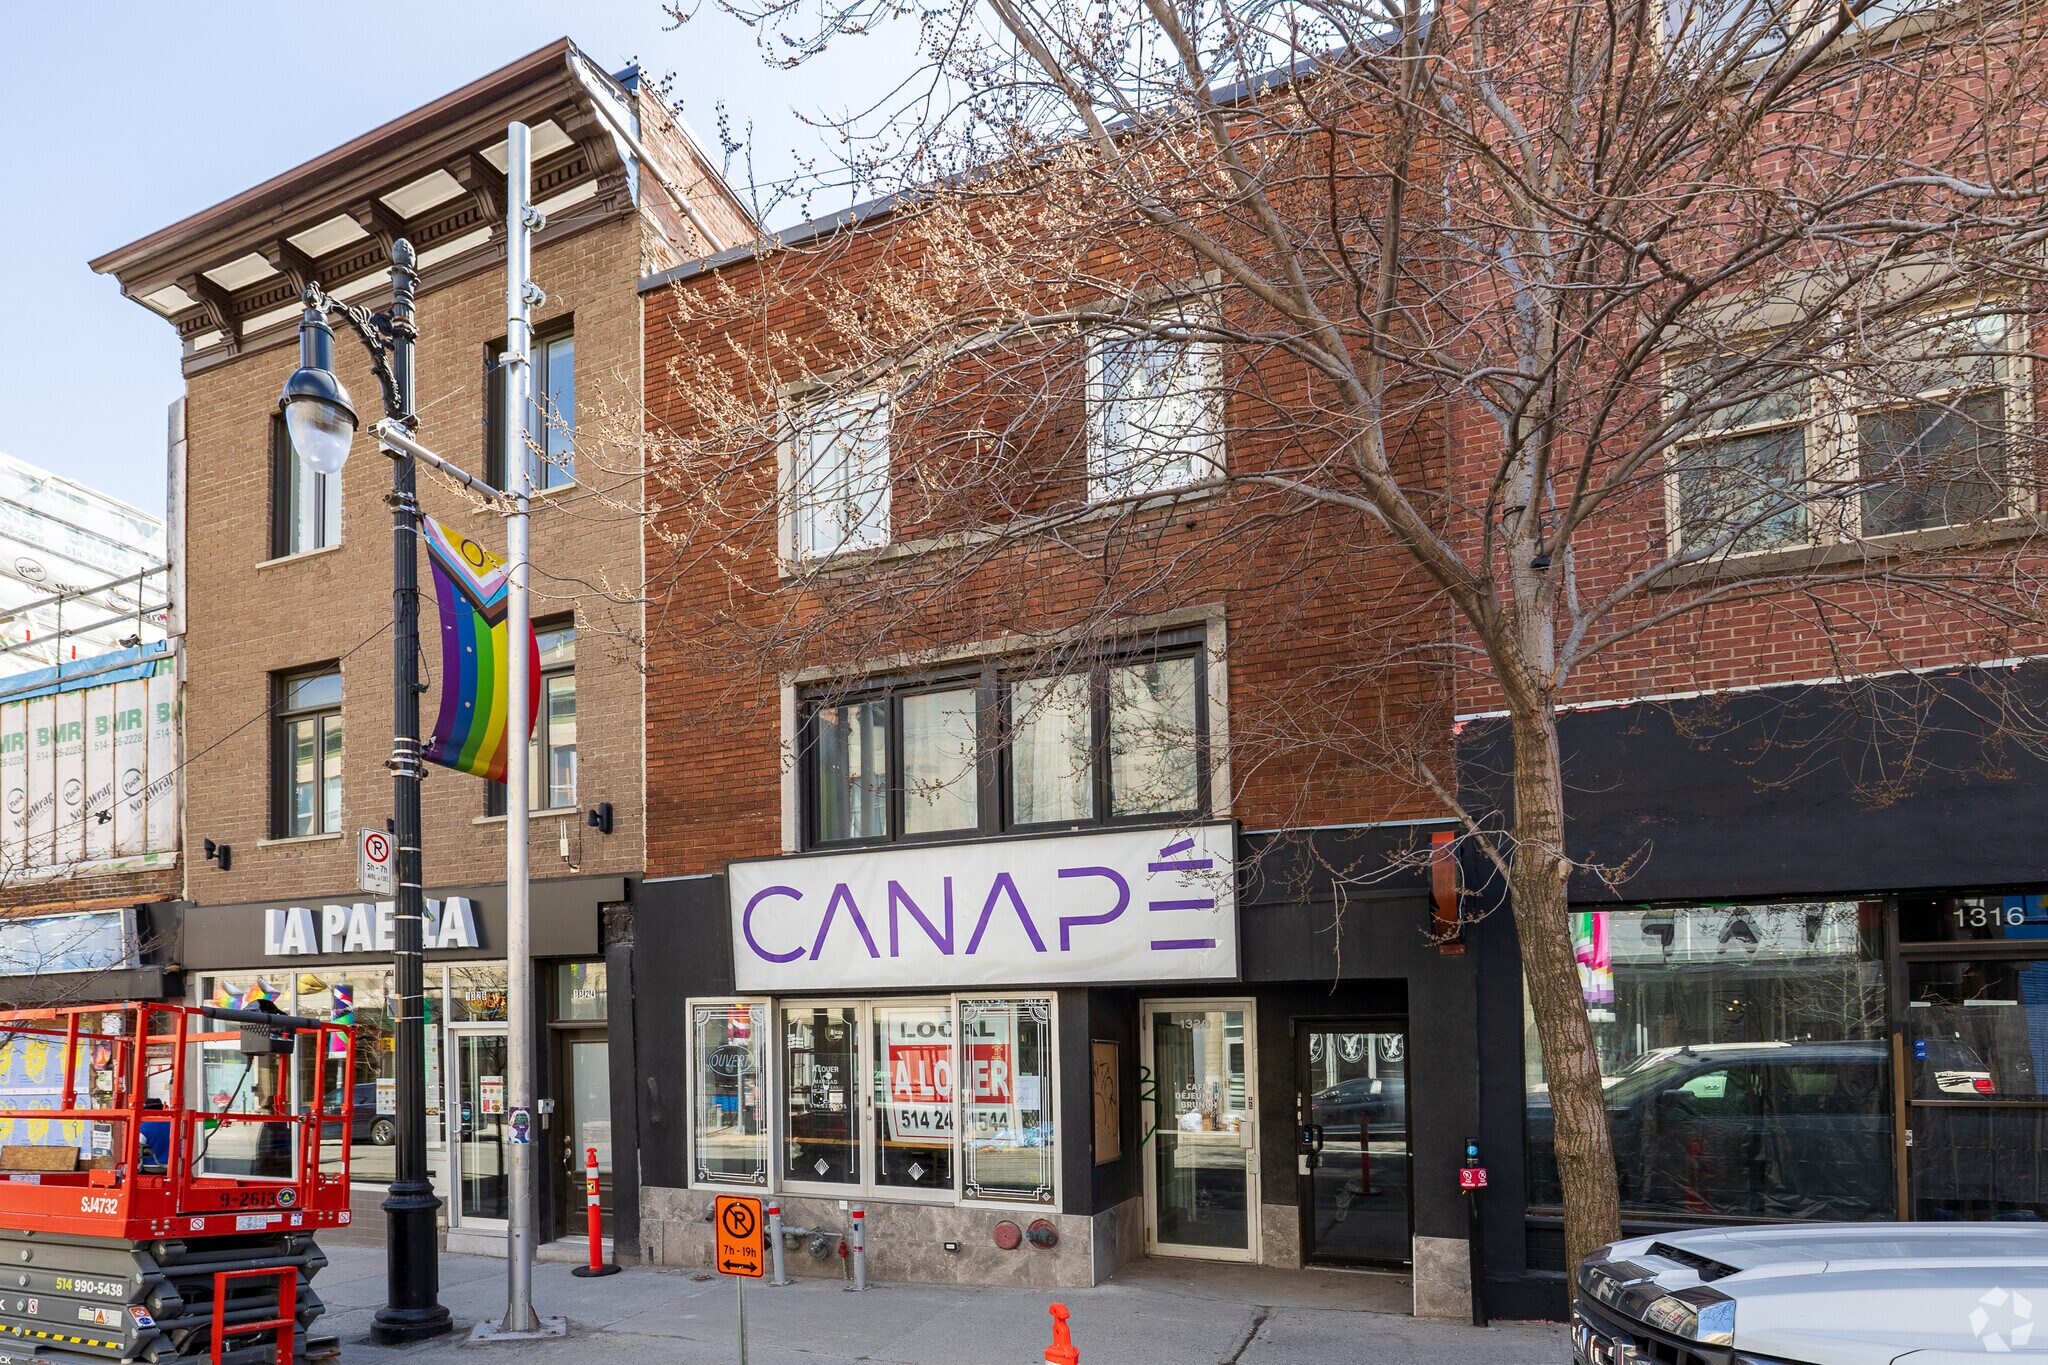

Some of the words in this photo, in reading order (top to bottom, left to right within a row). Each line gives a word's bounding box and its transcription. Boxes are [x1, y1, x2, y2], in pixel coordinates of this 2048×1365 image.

[366, 862, 375, 871] 5h
[380, 864, 388, 874] 7h
[743, 837, 1216, 963] CANAPÉ
[264, 906, 318, 956] LA
[322, 896, 479, 954] PAELA
[1953, 906, 2025, 928] 1316
[573, 989, 596, 999] 1324
[1180, 1019, 1211, 1030] 1320
[711, 1054, 751, 1068] OUVERT
[894, 1051, 913, 1096] À
[918, 1059, 1011, 1098] LOER
[1180, 1101, 1217, 1110] BRUNCH
[901, 1109, 931, 1129] 514
[81, 1196, 118, 1215] SJ4732
[220, 1191, 276, 1208] 9-2613
[723, 1244, 735, 1256] 7h
[742, 1246, 757, 1258] 19h
[55, 1276, 73, 1291] 514
[74, 1279, 123, 1297] 990-5438
